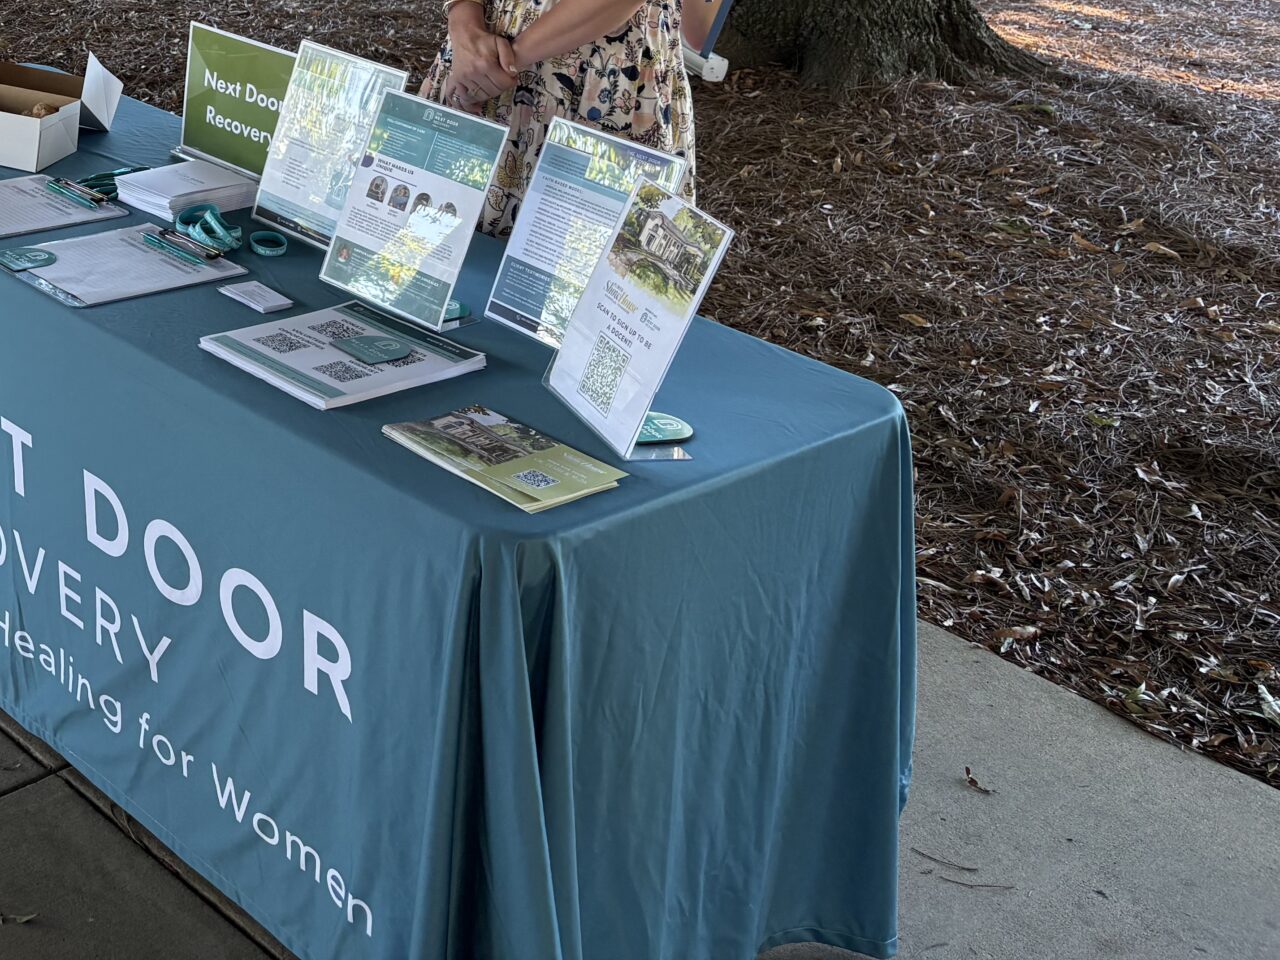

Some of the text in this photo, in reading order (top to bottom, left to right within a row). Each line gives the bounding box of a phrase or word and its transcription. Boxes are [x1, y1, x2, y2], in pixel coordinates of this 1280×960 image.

[204, 69, 241, 98] Next
[375, 163, 393, 173] UNIQUE
[377, 159, 391, 167] WHAT
[392, 163, 407, 173] MAKES
[597, 302, 610, 316] SCAN
[610, 312, 617, 322] TO
[617, 318, 629, 331] SIGN
[629, 327, 637, 337] UP
[637, 334, 645, 343] TO
[644, 339, 652, 350] BE
[83, 468, 353, 724] DOOR
[139, 712, 195, 778] for
[211, 761, 373, 938] Women
